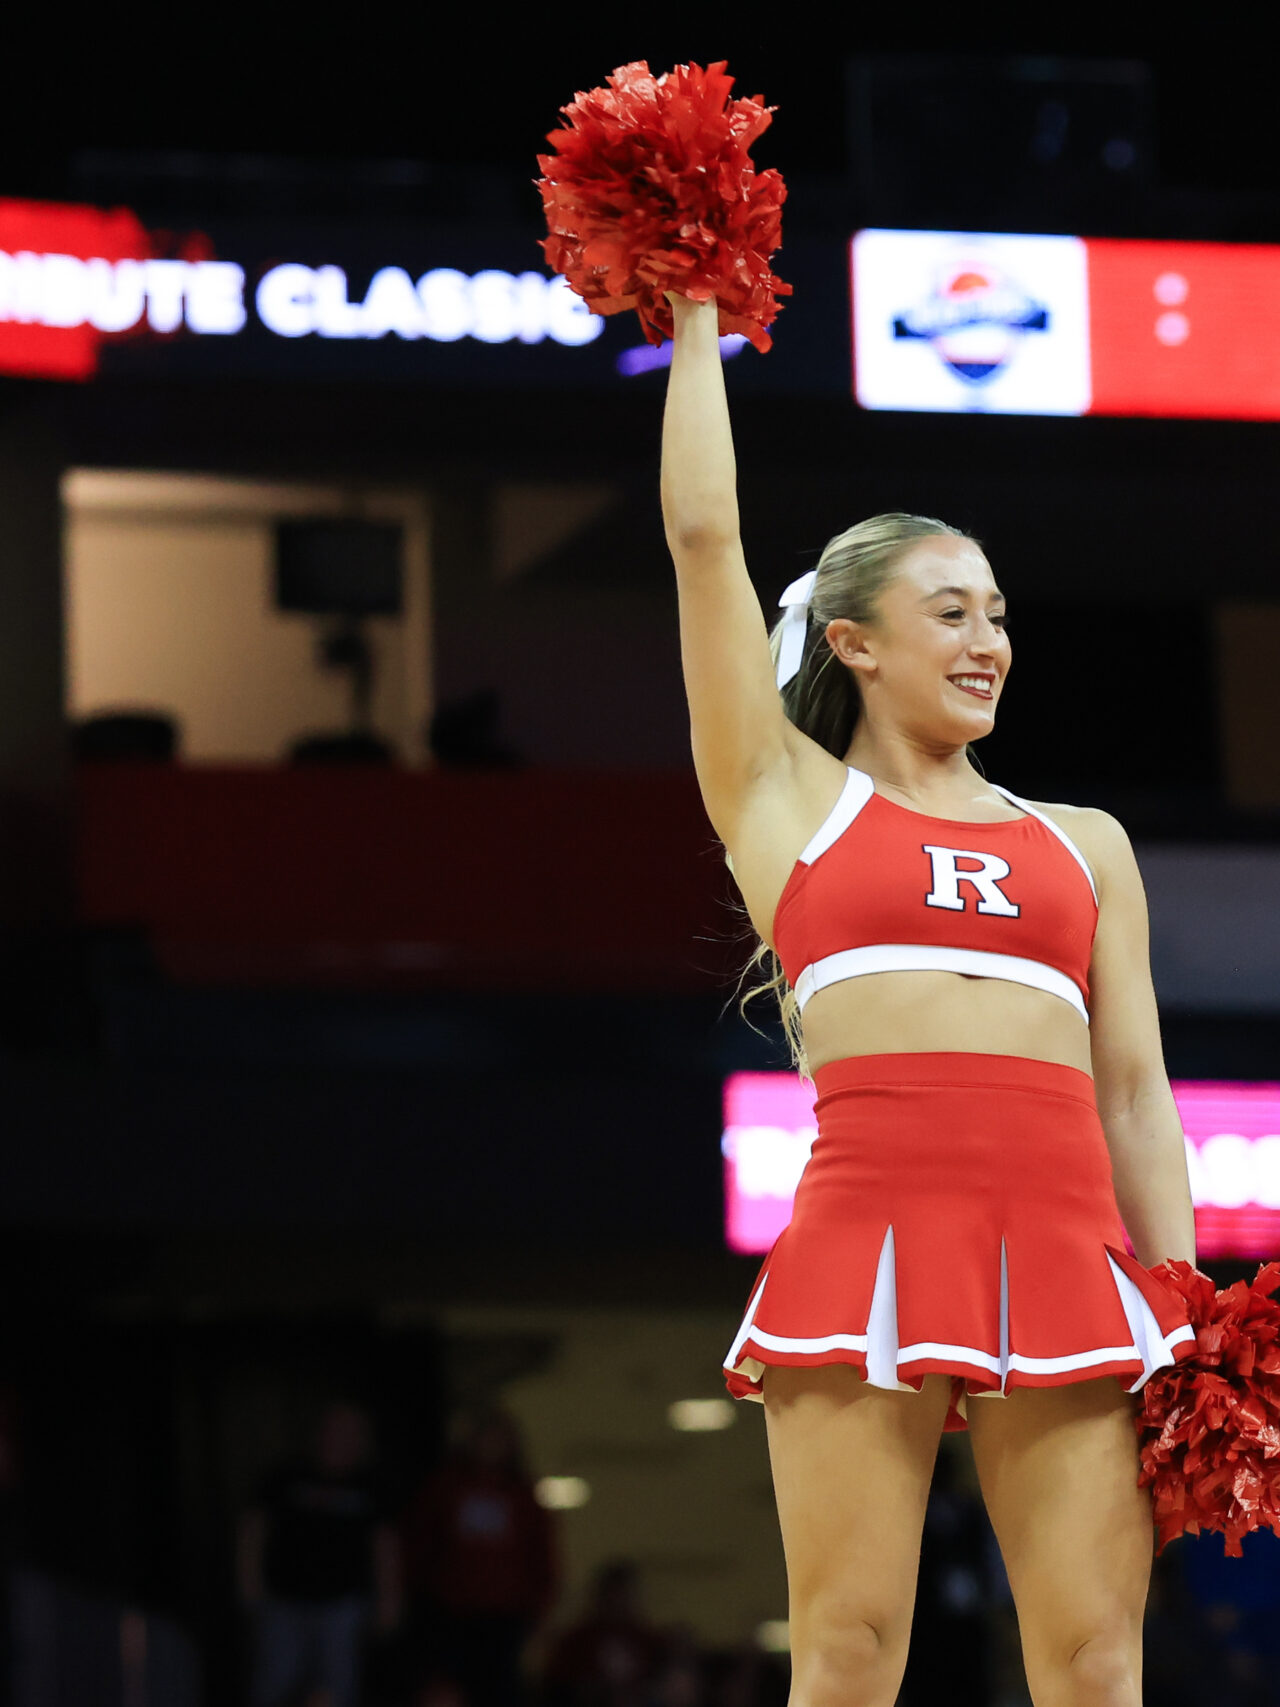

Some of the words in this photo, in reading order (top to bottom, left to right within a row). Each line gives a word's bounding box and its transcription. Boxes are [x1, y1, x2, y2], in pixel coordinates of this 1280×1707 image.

[0, 249, 247, 335] IBUTE
[255, 263, 605, 346] CLASSIC
[922, 844, 1020, 919] R
